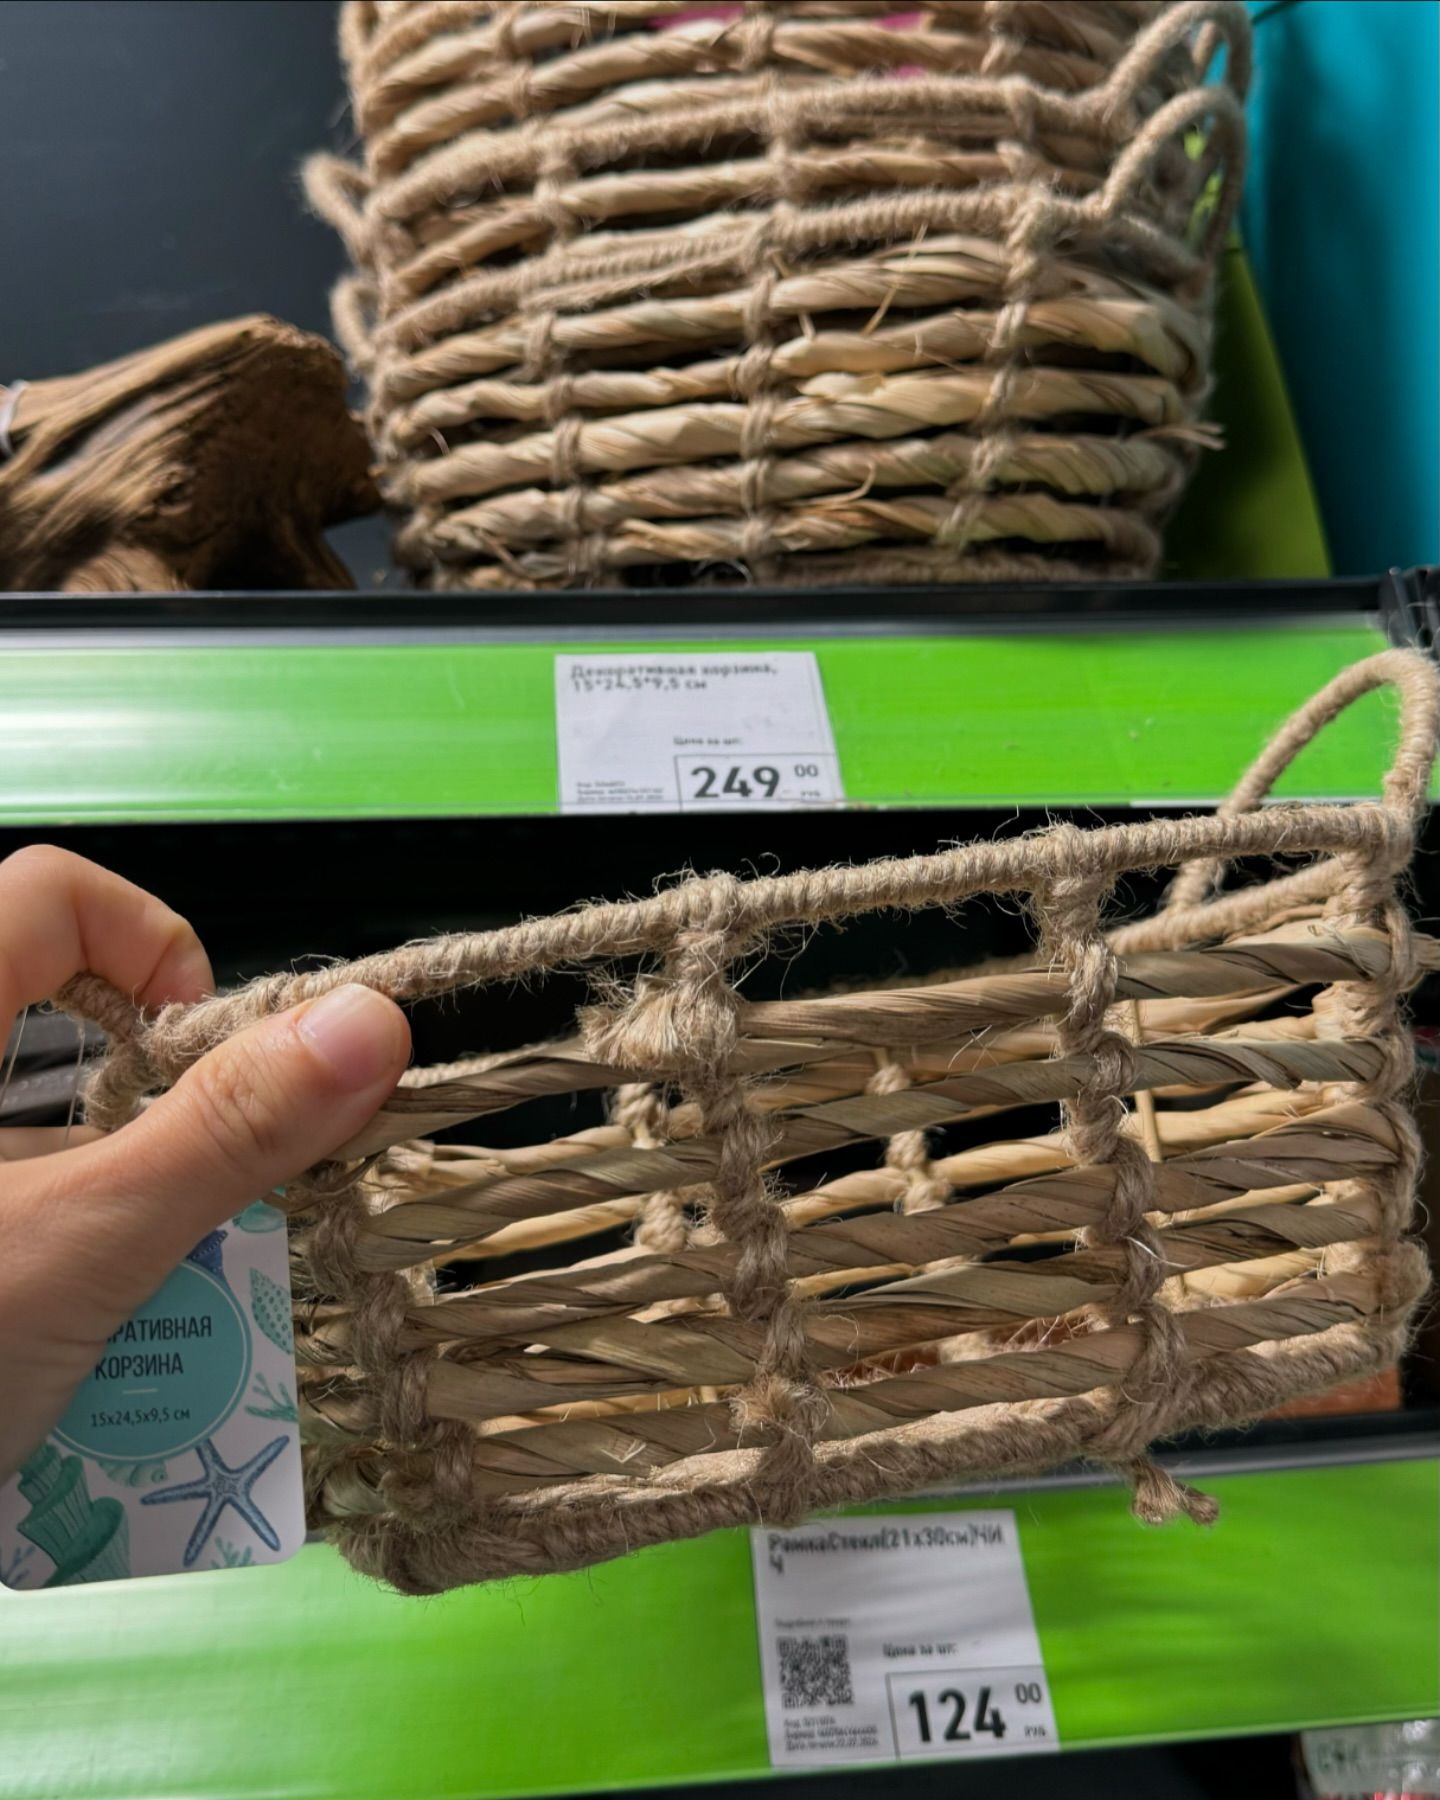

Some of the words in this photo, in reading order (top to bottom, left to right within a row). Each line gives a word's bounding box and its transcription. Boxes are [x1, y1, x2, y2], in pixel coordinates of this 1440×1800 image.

[685, 679, 709, 690] см
[691, 766, 780, 799] 249
[794, 764, 818, 778] 00
[107, 1316, 212, 1344] РАТИВНАЯ
[95, 1353, 184, 1381] КОРЗИНА
[174, 1409, 190, 1421] см
[1014, 1683, 1042, 1704] 00
[909, 1686, 1006, 1743] 124
